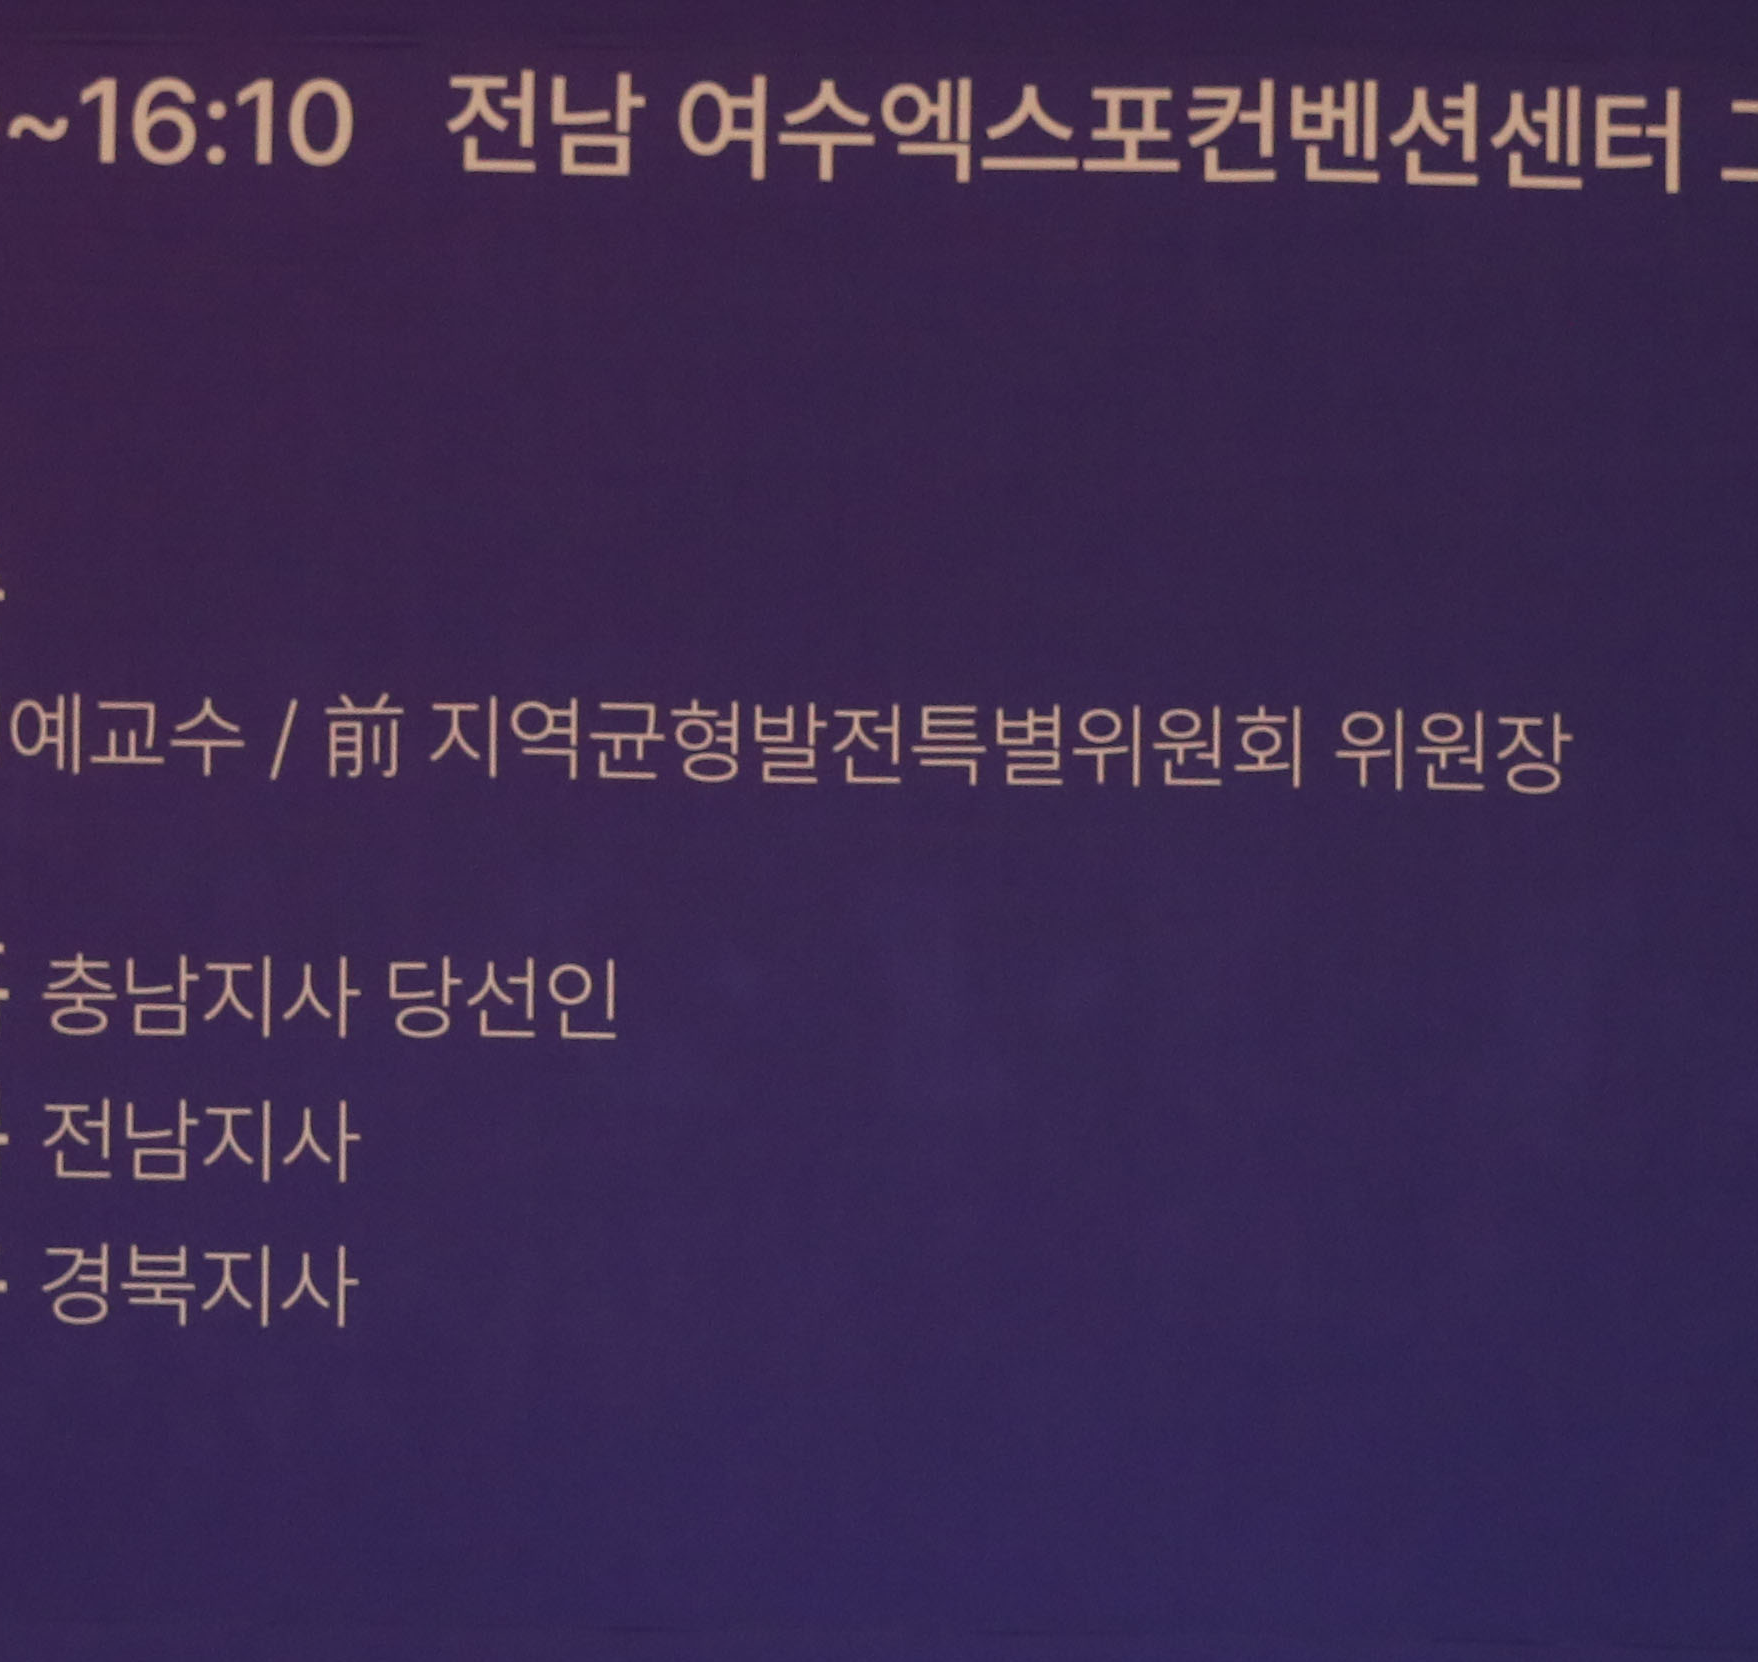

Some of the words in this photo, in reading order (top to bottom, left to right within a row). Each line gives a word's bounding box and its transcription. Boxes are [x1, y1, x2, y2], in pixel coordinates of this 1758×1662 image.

[447, 69, 646, 176] 전남
[678, 74, 1680, 194] 여수엑스포컨벤션센터
[325, 693, 404, 778] 前
[430, 695, 1301, 788] 지역균형발전특별위원회
[1336, 708, 1573, 794] 위원장
[42, 953, 361, 1038] 충남지사
[389, 956, 616, 1040] 당선인
[43, 1098, 361, 1183] 전남지사
[42, 1243, 359, 1328] 경북지사
